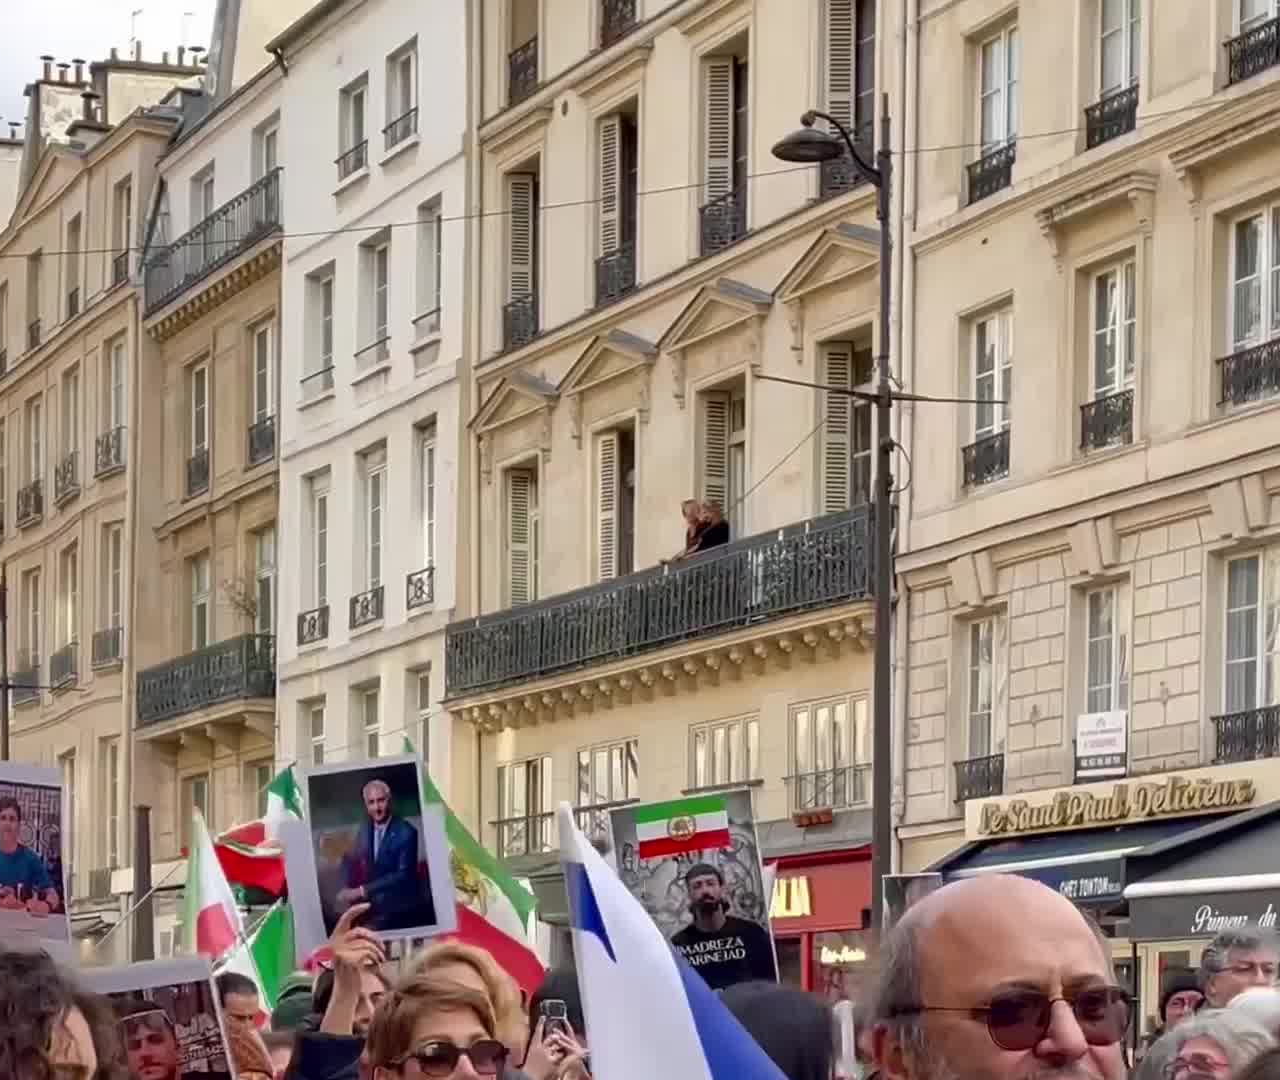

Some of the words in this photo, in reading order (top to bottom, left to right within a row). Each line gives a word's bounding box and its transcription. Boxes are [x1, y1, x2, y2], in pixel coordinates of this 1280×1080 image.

[976, 802, 1007, 835] Le
[1006, 793, 1068, 831] Saint
[1191, 904, 1249, 933] Primeur
[1258, 903, 1278, 928] du
